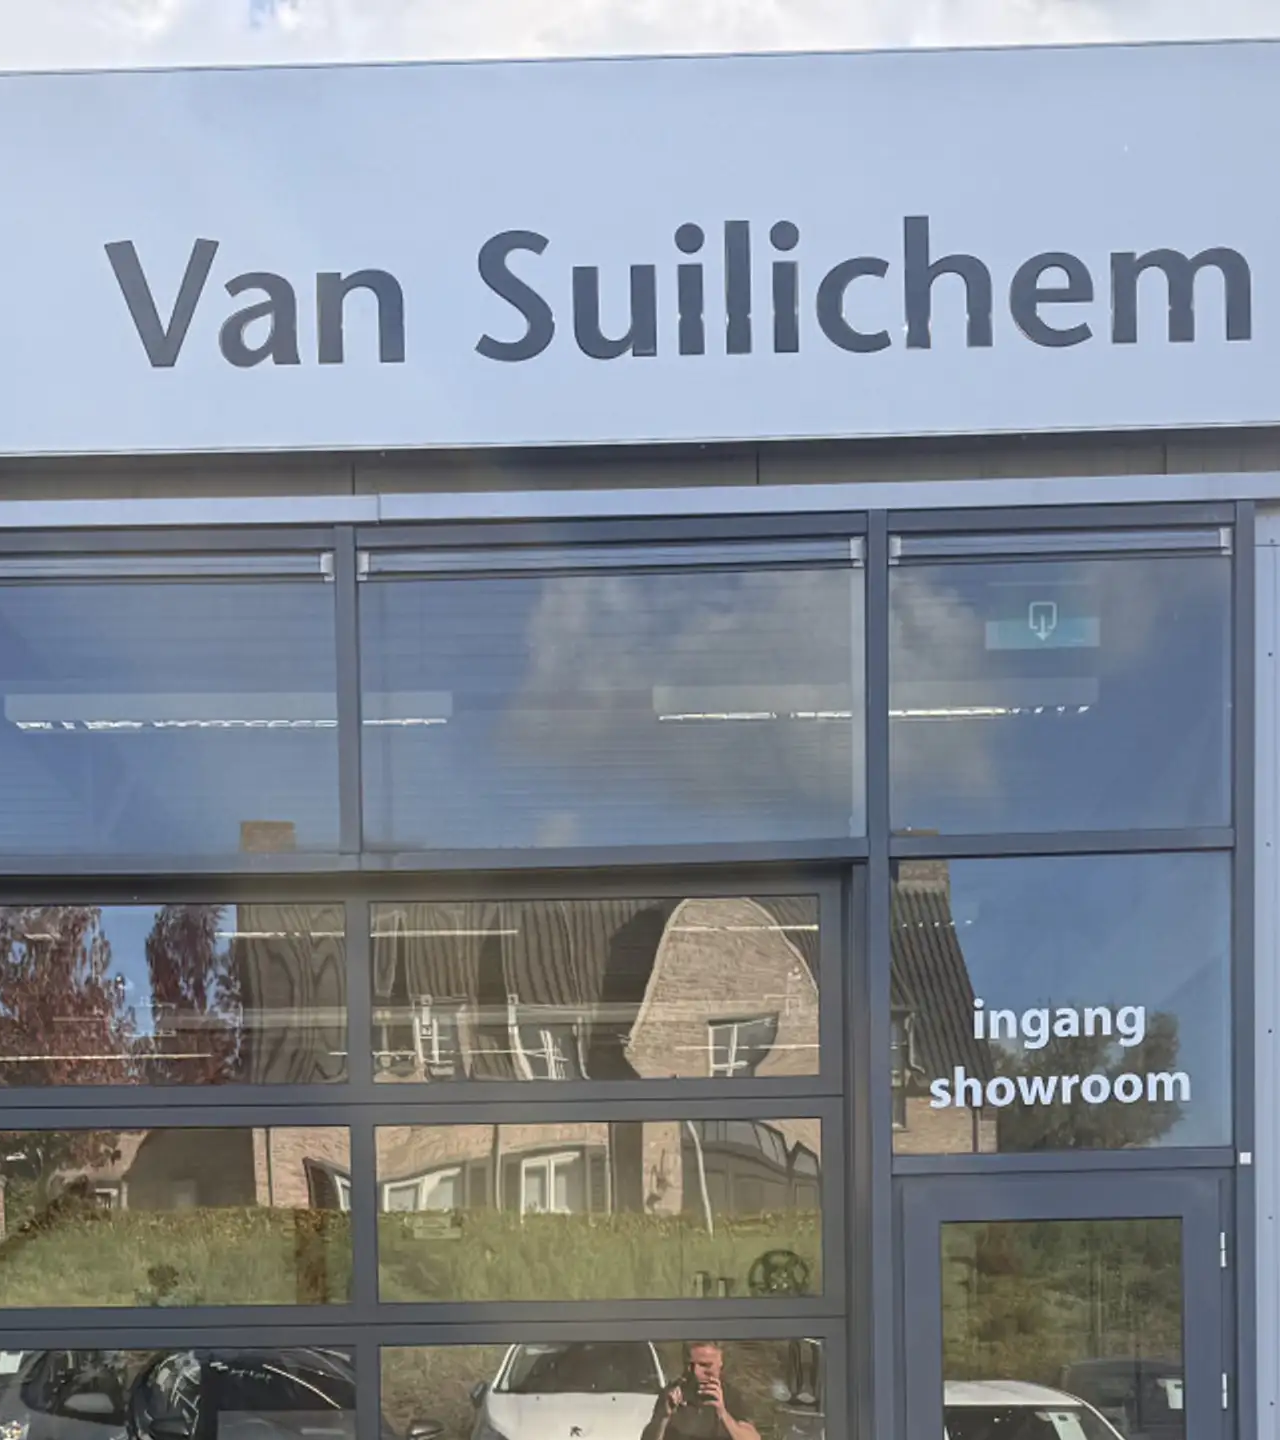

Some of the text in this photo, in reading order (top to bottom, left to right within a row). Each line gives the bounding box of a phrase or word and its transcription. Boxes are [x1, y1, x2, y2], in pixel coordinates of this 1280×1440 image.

[104, 215, 1253, 368] Van Suilichem
[973, 998, 1145, 1049] ingang
[929, 1066, 1191, 1108] showroom
